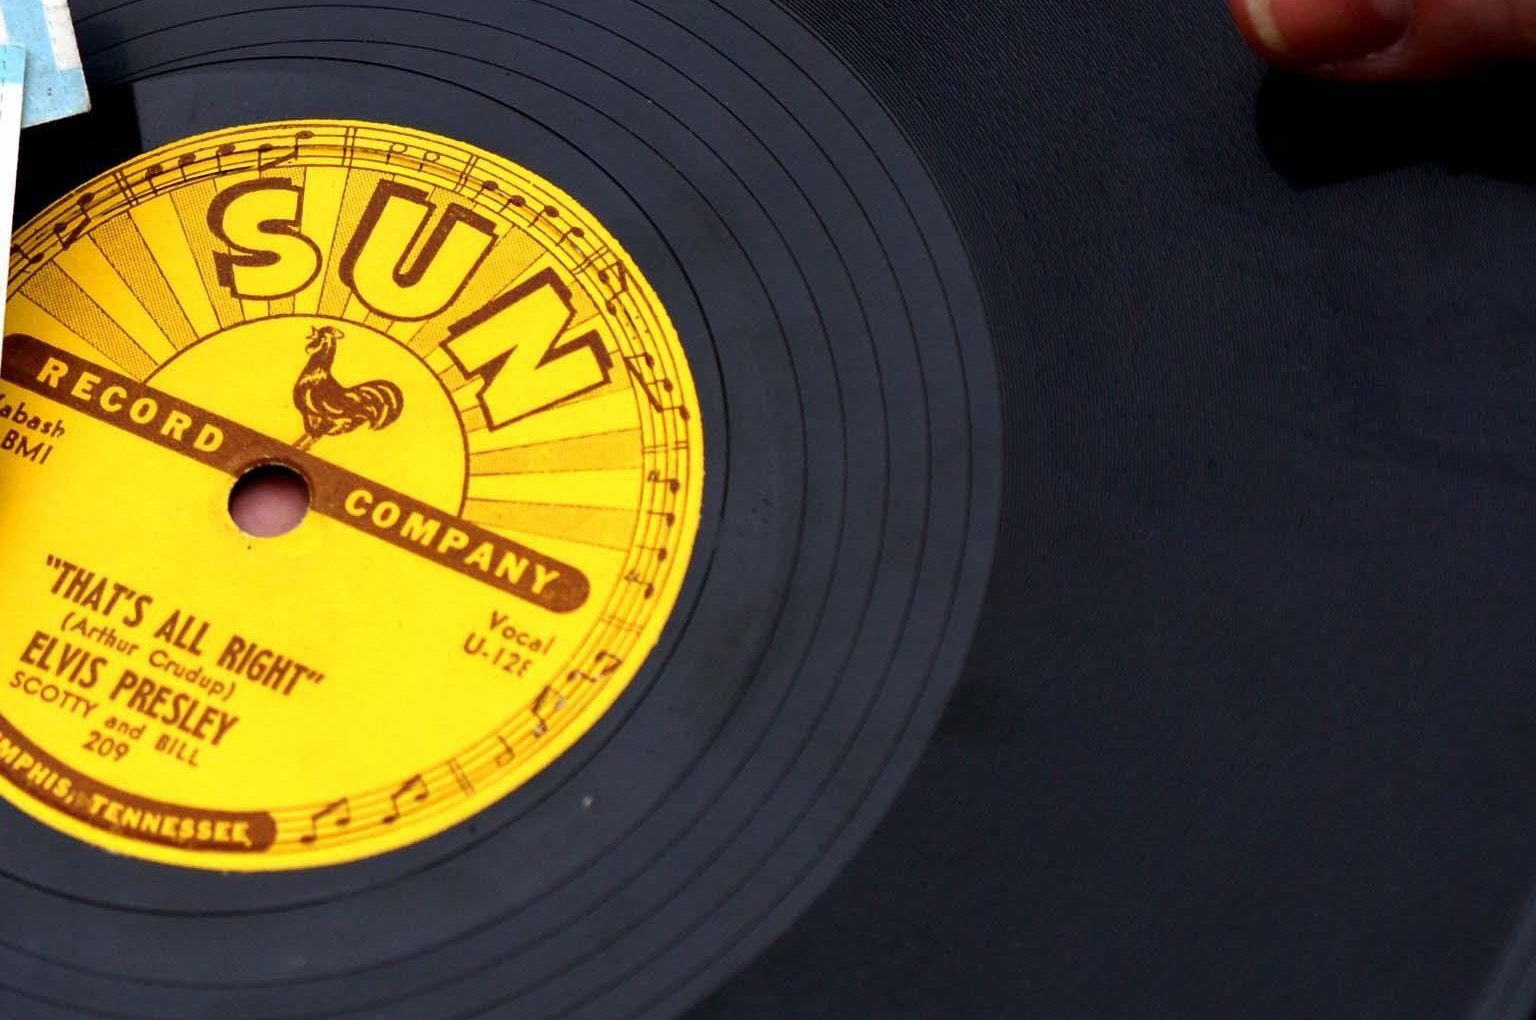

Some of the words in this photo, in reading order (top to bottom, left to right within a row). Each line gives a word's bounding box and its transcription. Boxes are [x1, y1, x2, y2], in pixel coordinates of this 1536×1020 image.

[207, 177, 613, 432] SUN
[1, 429, 54, 465] BMI
[36, 357, 224, 453] RECORD
[344, 490, 560, 595] COMPANY
[46, 554, 154, 628] "THAT'S
[153, 609, 210, 657] ALL
[216, 635, 325, 697] RIGHT"
[61, 611, 139, 657] (Arthur
[148, 649, 237, 702] Crudup)
[489, 610, 557, 656] Vocal
[9, 671, 100, 719] SCOTTY
[104, 717, 147, 741] and
[154, 733, 200, 768] BILL
[20, 630, 107, 689] ELVIS
[109, 669, 240, 746] PRESLEY
[82, 731, 130, 762] 209
